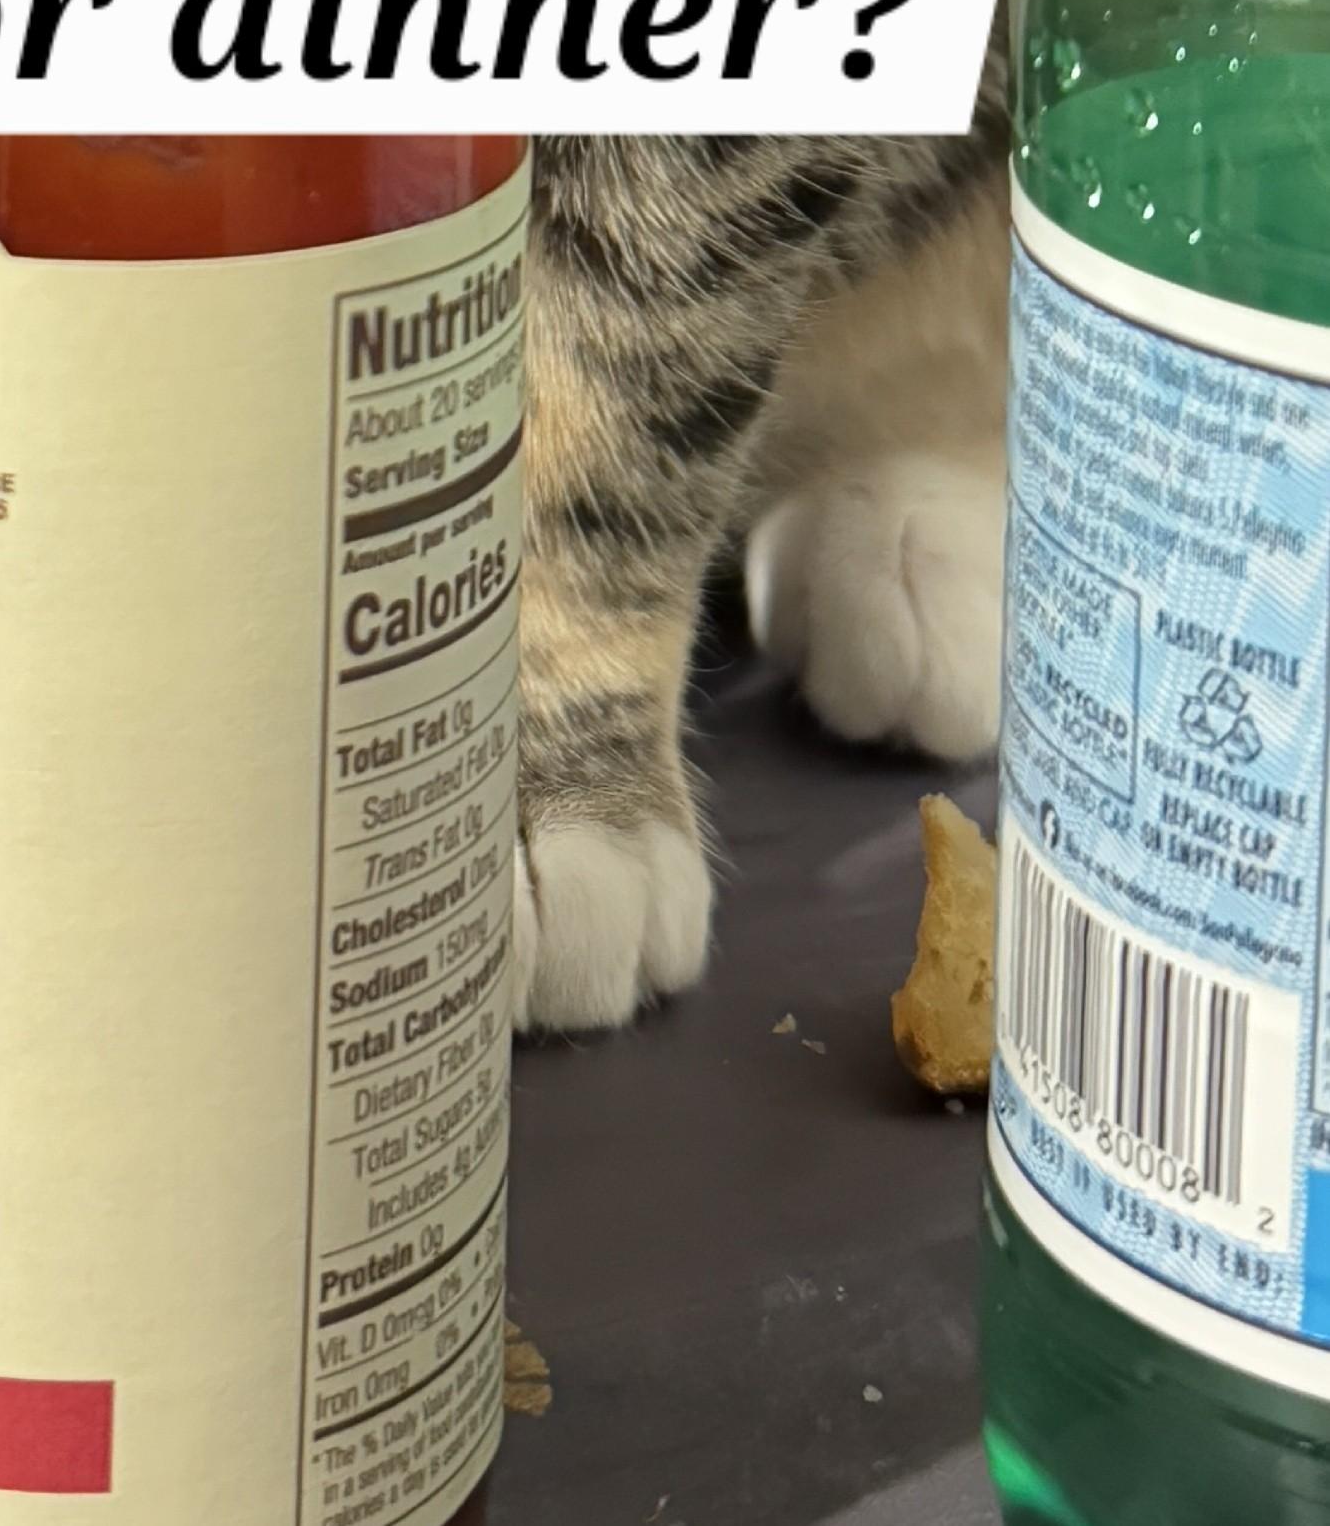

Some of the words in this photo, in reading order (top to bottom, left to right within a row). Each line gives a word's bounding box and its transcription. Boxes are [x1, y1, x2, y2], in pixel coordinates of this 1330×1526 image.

[344, 391, 423, 447] About
[430, 380, 459, 418] 20
[343, 444, 446, 499] Serving
[453, 419, 489, 464] Size
[343, 538, 507, 656] Calories
[336, 727, 405, 778] Total
[411, 710, 447, 753] Fat
[361, 755, 463, 831] Saturated
[364, 840, 428, 889] Trans
[433, 815, 461, 858] Fat
[331, 867, 466, 956] Cholesterol
[329, 955, 428, 1015] Sodium
[327, 1020, 396, 1073] Total
[353, 1066, 432, 1124] Dietary
[352, 1127, 409, 1179] Total
[1096, 1117, 1201, 1205] 80008
[1257, 1205, 1275, 1235] 2
[367, 1164, 449, 1230] Includes
[320, 1242, 414, 1303] Protein
[317, 1335, 352, 1371] Vit.
[361, 1324, 377, 1354] D
[315, 1386, 358, 1423] Iron
[364, 1360, 411, 1402] 0mg
